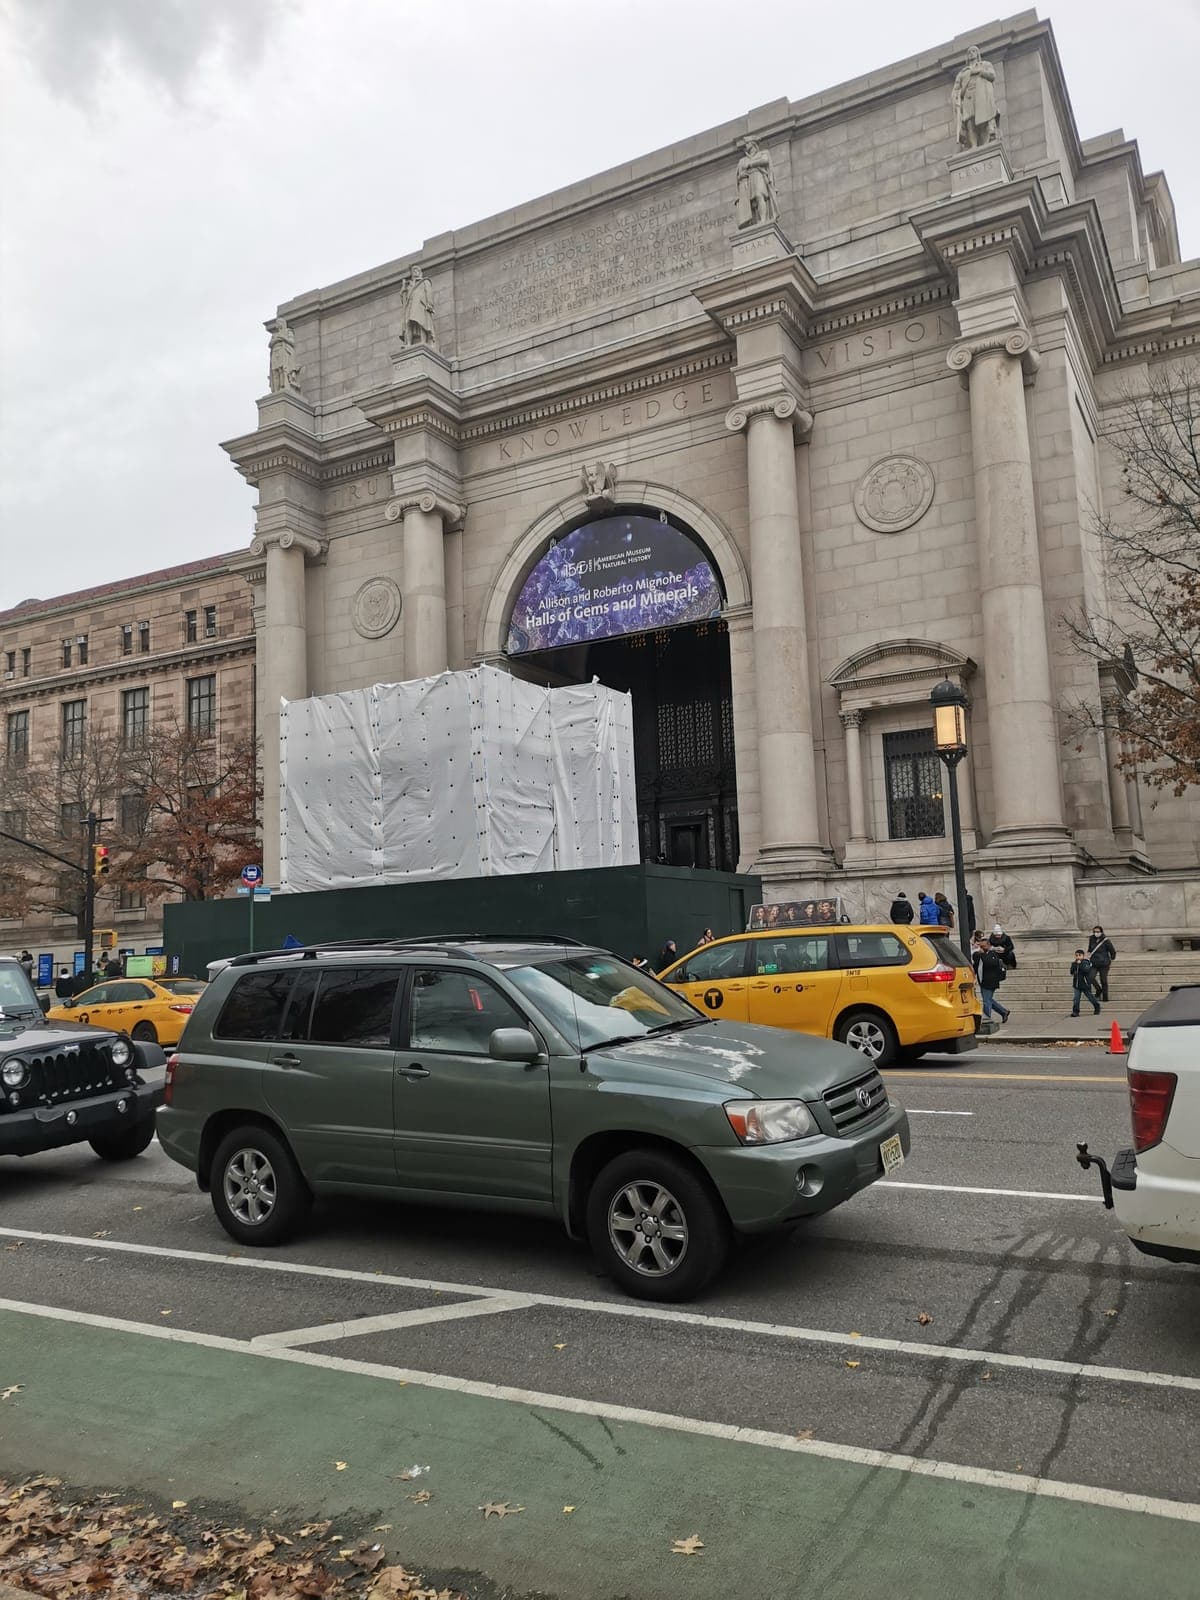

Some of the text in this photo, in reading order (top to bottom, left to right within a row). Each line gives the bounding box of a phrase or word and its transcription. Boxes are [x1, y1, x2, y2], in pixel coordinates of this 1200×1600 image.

[498, 383, 713, 461] KNOWLEDGE
[597, 552, 625, 563] AMERICAN
[625, 547, 651, 557] MUSEUM
[602, 560, 627, 569] NATURAL
[628, 554, 652, 564] HISTORY
[526, 583, 699, 629] Halls of Gems and Minerals
[538, 573, 682, 610] Allison and Roberto Mignone
